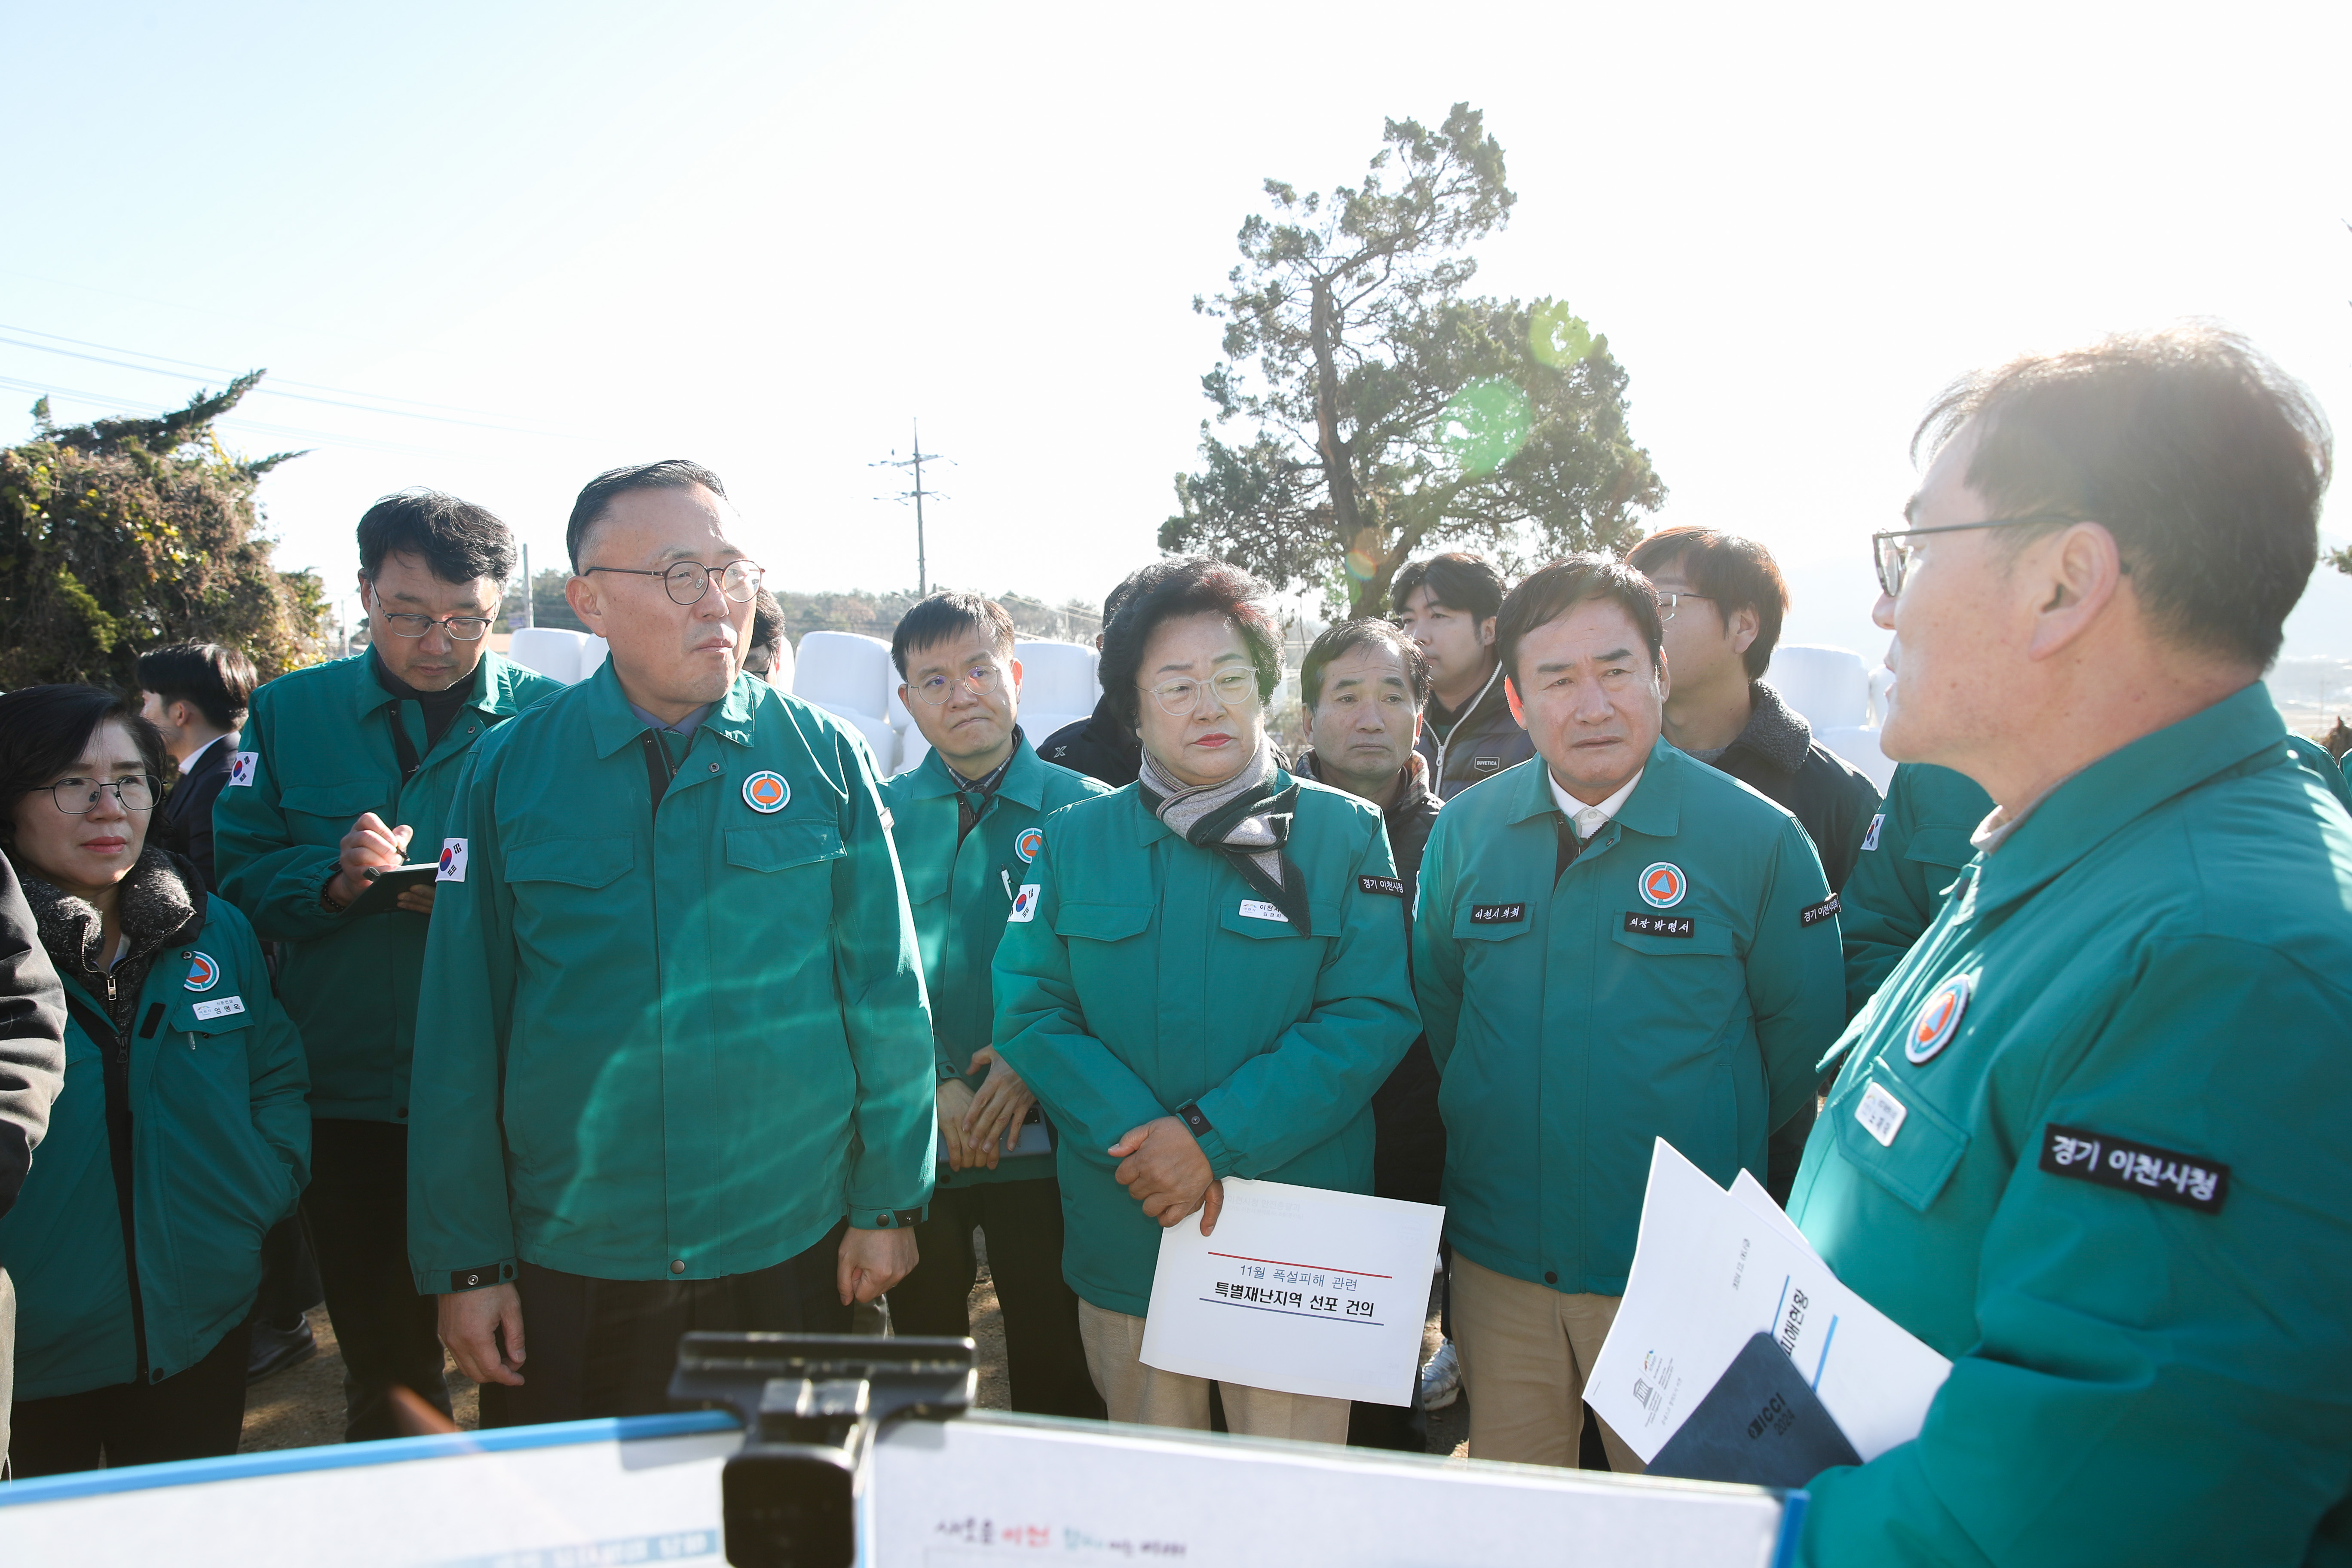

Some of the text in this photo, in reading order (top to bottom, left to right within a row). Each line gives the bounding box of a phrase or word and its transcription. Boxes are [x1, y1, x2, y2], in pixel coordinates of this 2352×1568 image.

[1363, 879, 1404, 893] 경기 이천시청
[1804, 898, 1839, 922] 경기 이천시의회
[1629, 917, 1689, 933] 의장 박명서
[2051, 1134, 2219, 1201] 경기 이천시청
[1240, 1265, 1358, 1292] 11월 폭설피해 관련
[1215, 1281, 1375, 1317] 특별재난지역 선포 건의
[1757, 1391, 1786, 1428] ICCI
[1773, 1408, 1796, 1436] 2024
